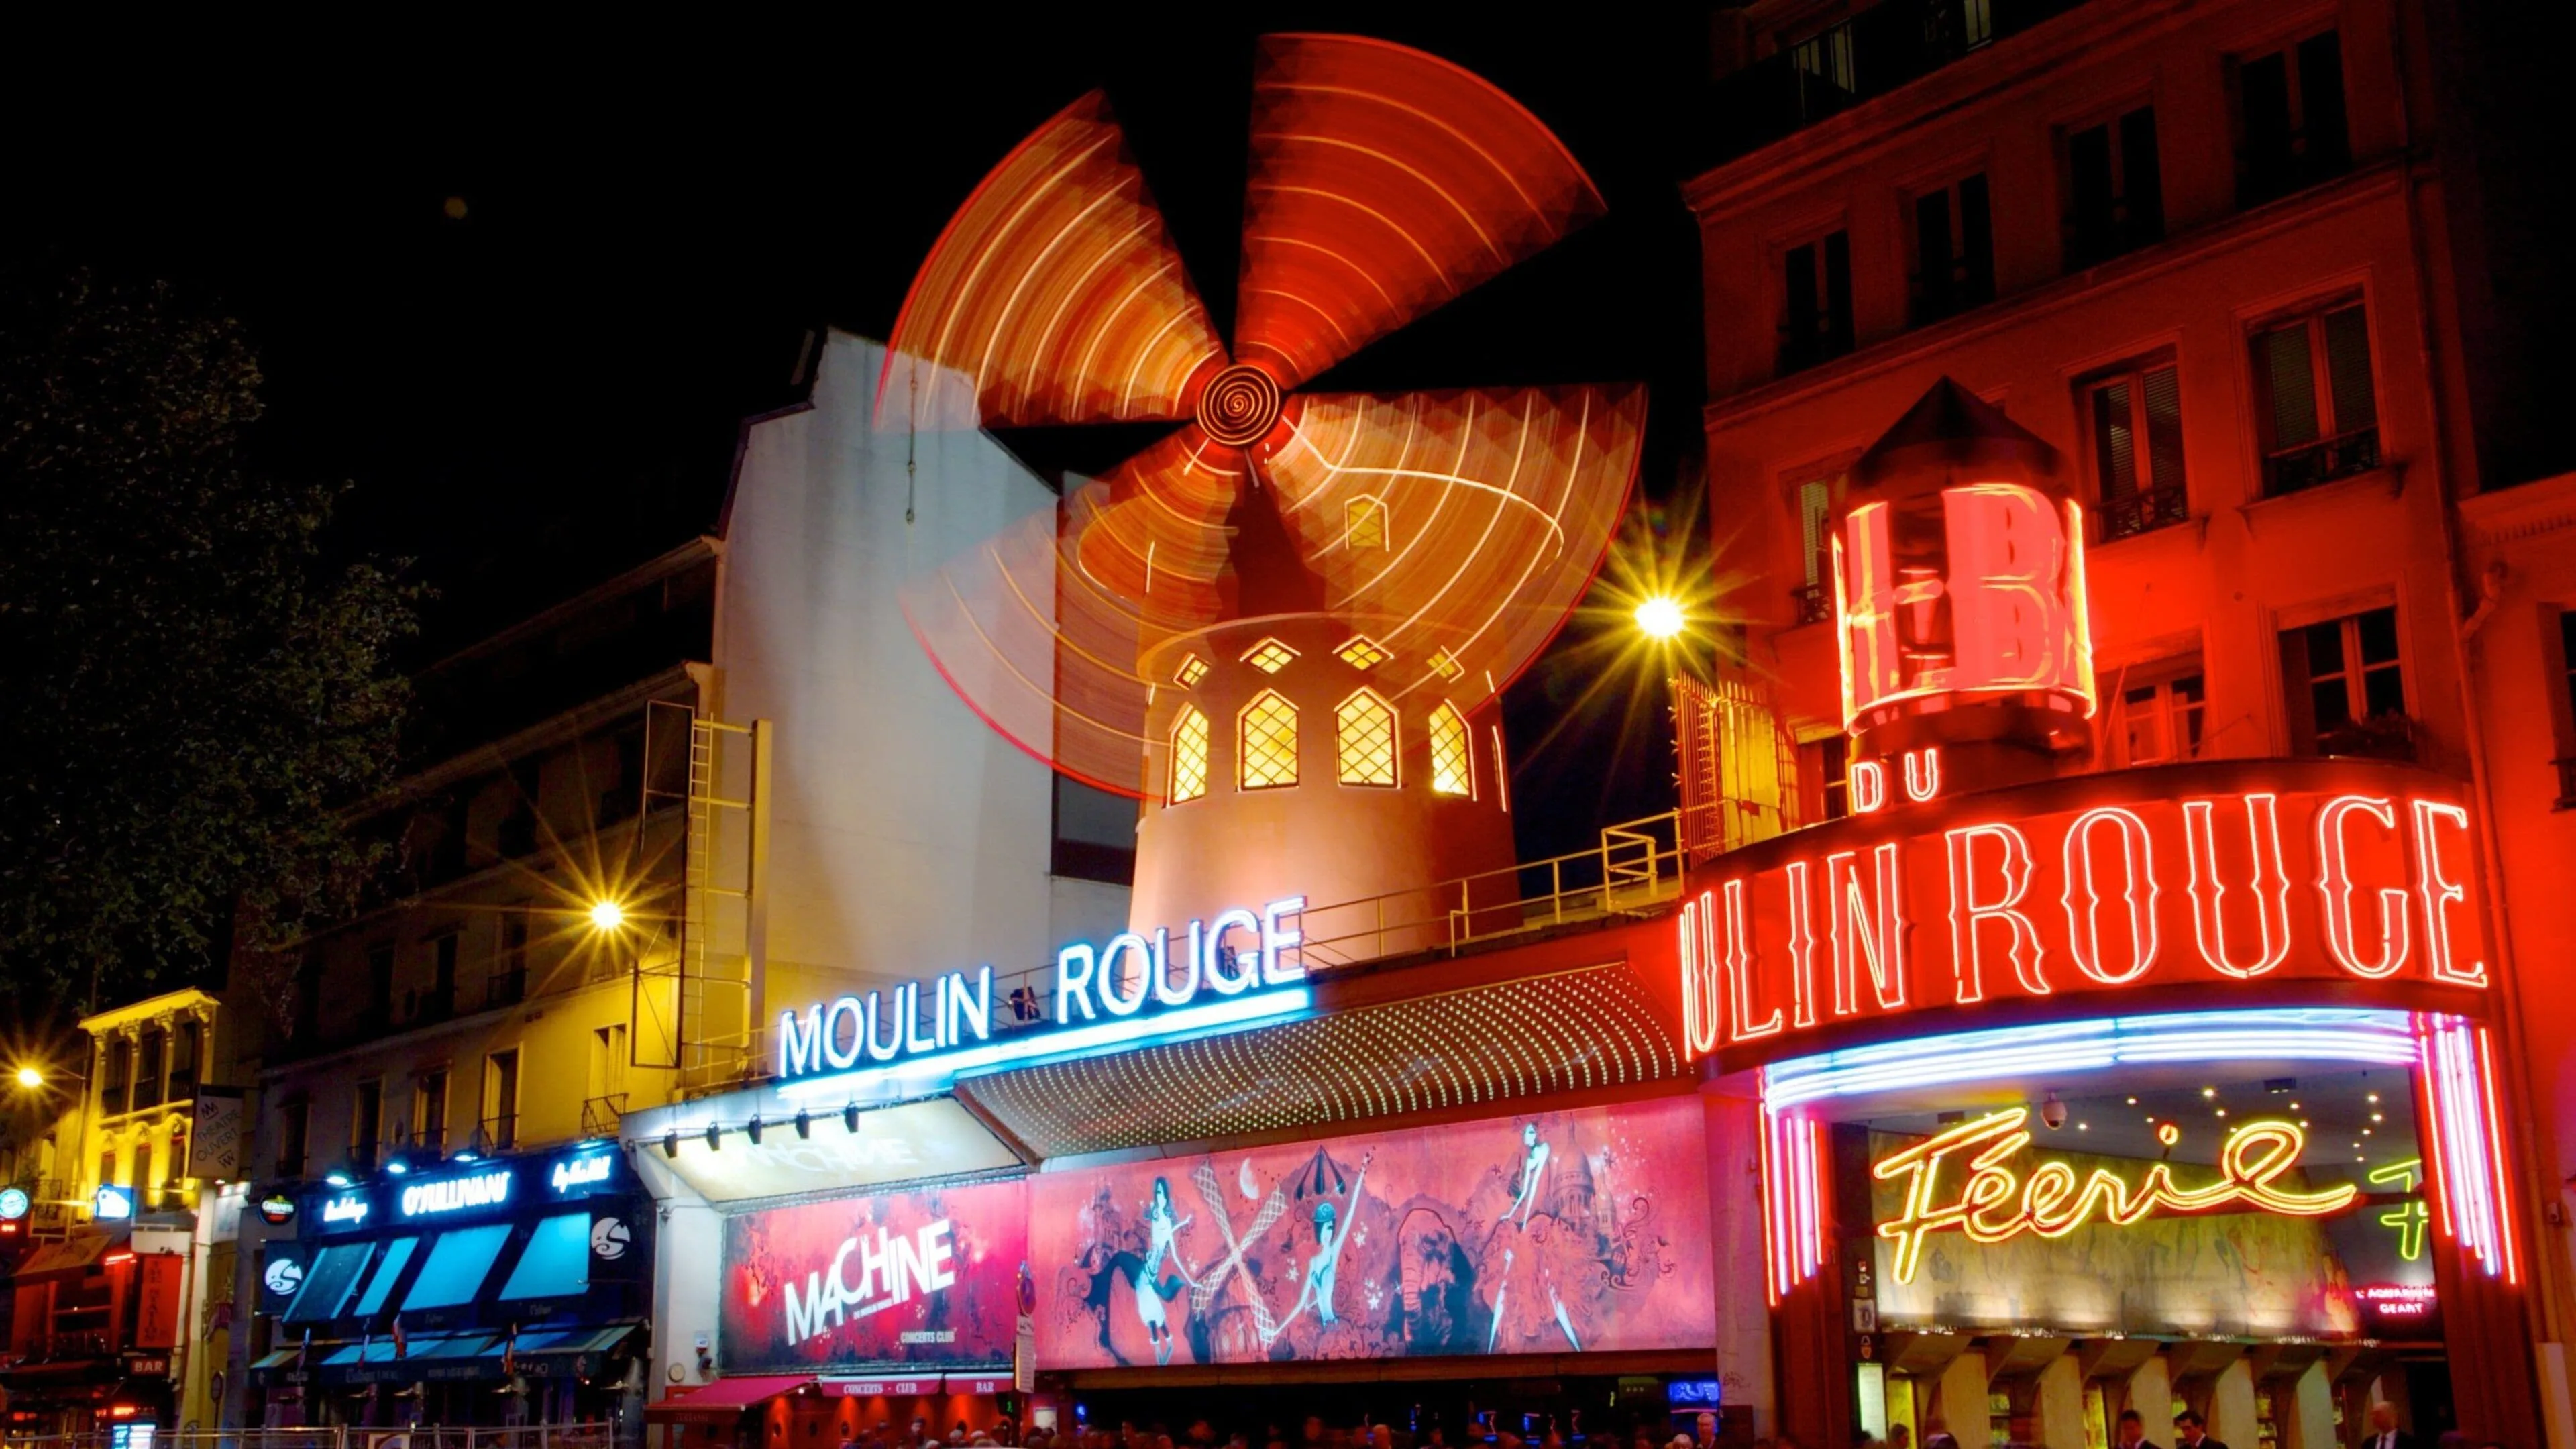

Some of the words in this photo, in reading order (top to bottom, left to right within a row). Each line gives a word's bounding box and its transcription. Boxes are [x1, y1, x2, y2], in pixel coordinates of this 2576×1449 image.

[1850, 748, 1940, 814] DU
[1679, 843, 1905, 1062] ULIN
[1944, 793, 2489, 1004] ROUGE
[779, 964, 994, 1078] MOULIN
[1057, 895, 1309, 1024] ROUGE
[196, 1127, 239, 1161] OUVERT
[402, 1171, 511, 1216] O'SULLIVANS
[1874, 1106, 2357, 1285] Féerie
[784, 1218, 955, 1346] MACHINE
[900, 1332, 935, 1344] CONCERTS
[936, 1331, 955, 1343] CLUB
[134, 1360, 163, 1372] BAR
[843, 1383, 883, 1395] CONCERTS
[896, 1382, 917, 1395] CLUB
[976, 1381, 994, 1393] BAR
